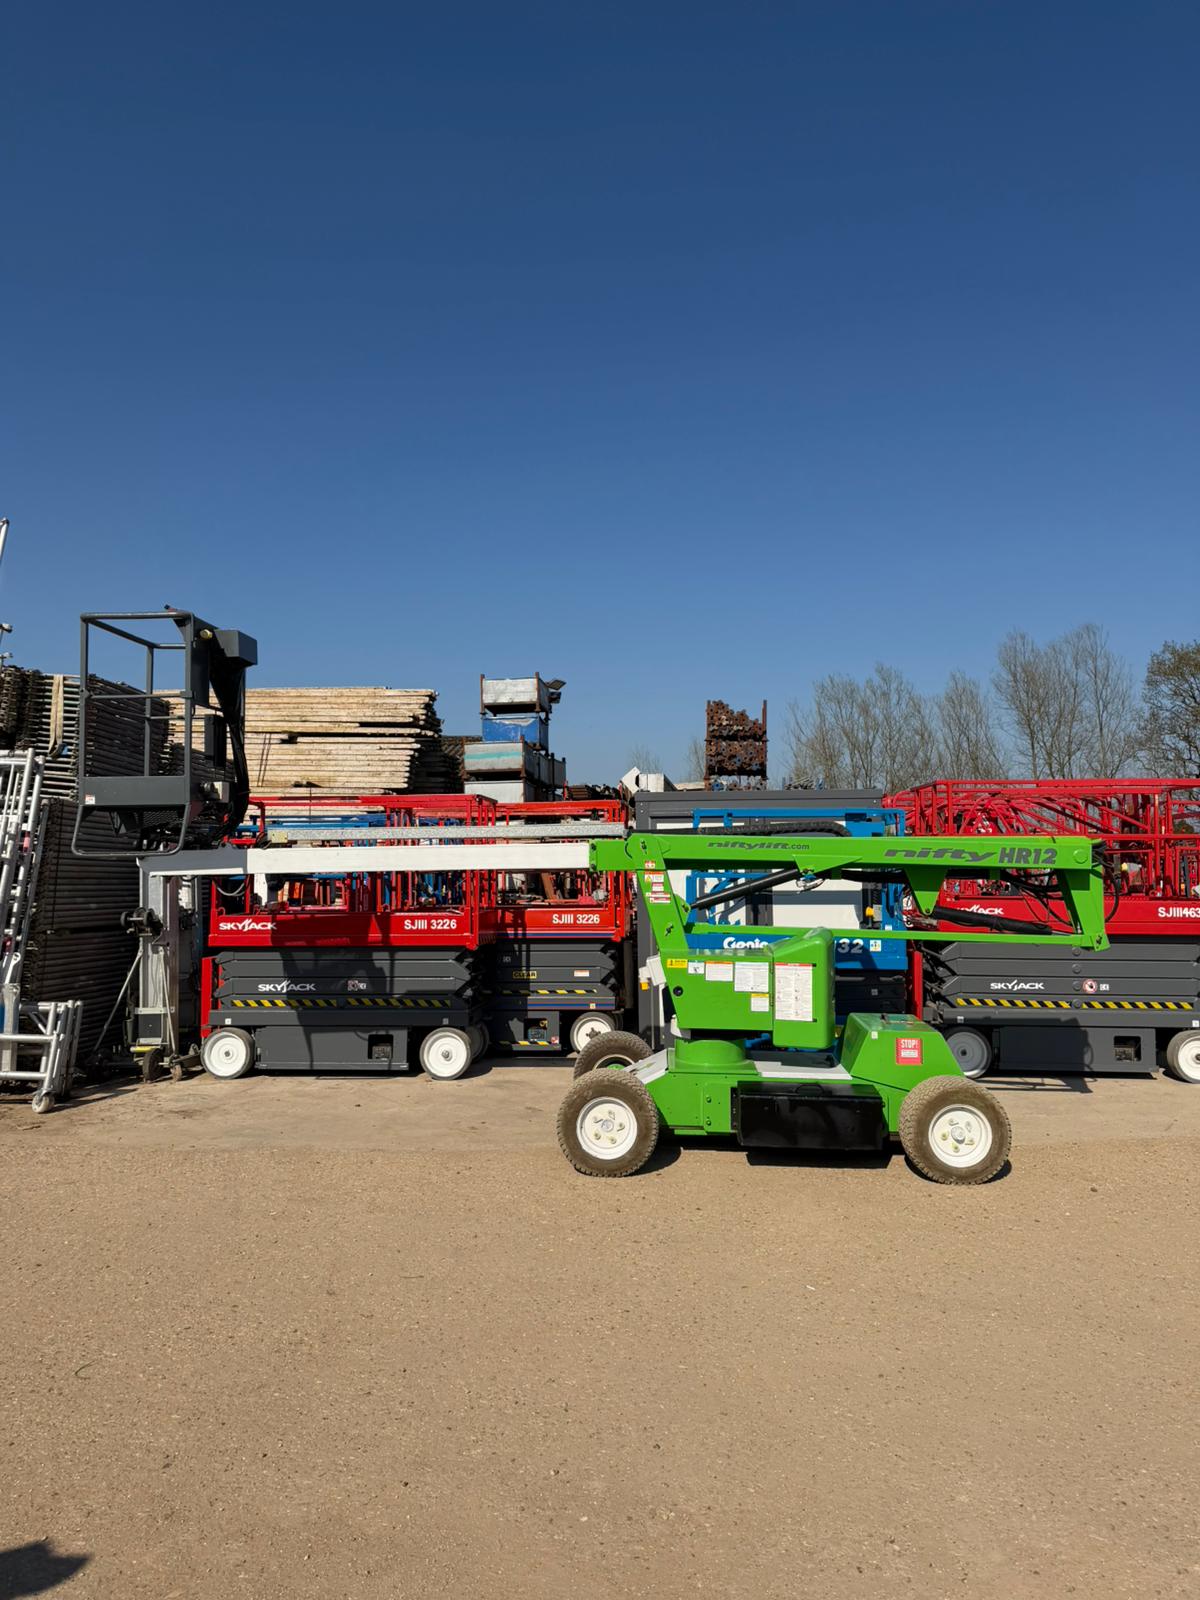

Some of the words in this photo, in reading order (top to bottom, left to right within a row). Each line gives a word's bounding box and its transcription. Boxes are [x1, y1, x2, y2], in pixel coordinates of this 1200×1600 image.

[706, 841, 810, 851] niftylift.com
[884, 848, 997, 862] nifty
[998, 847, 1058, 865] HR12
[404, 919, 428, 930] SJIII
[430, 919, 457, 930] 3226
[552, 913, 574, 924] SJIII
[576, 913, 600, 924] 3226
[218, 918, 277, 932] SKYJACK
[258, 979, 317, 993] SKYJACK
[990, 979, 1045, 991] SKYJACK
